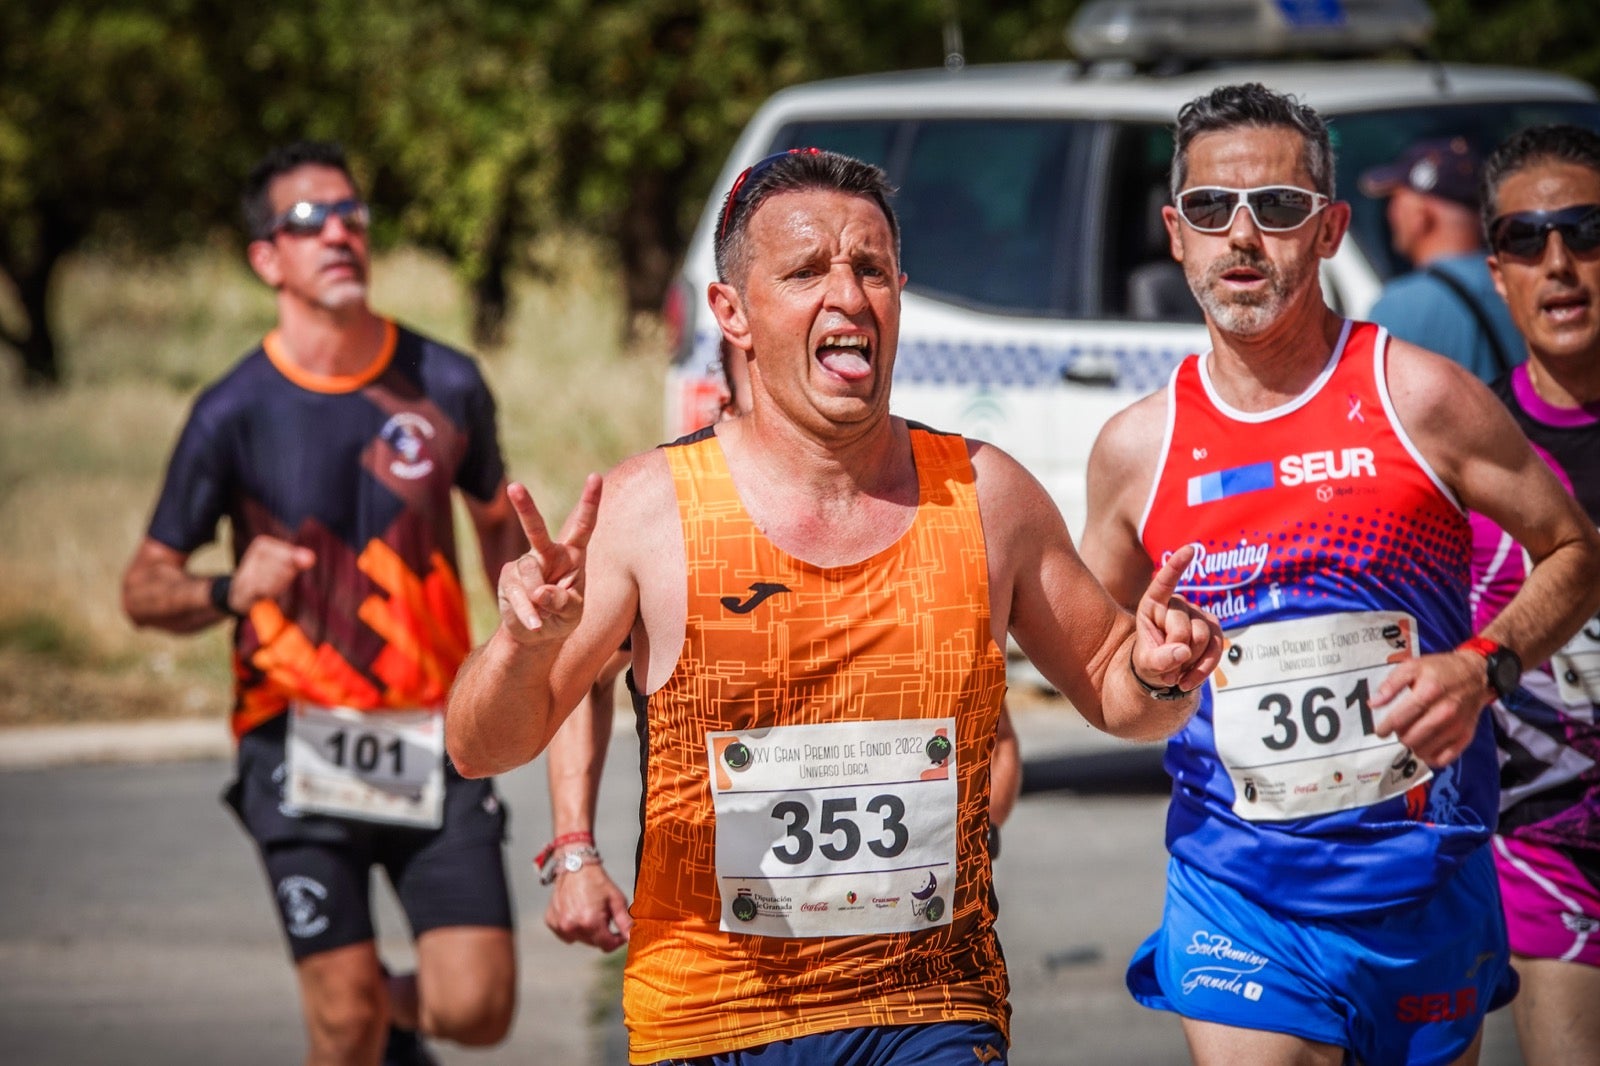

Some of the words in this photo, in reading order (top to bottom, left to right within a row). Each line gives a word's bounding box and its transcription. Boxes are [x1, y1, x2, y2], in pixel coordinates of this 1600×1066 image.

[1279, 447, 1376, 486] SEUR
[1258, 677, 1376, 751] 361
[327, 729, 404, 775] 101
[804, 743, 840, 761] PREMIO
[860, 739, 892, 758] FONDO
[895, 736, 923, 755] 2022
[799, 763, 839, 779] UNIVERSO
[842, 760, 869, 776] LORCA
[771, 795, 909, 865] 353
[754, 893, 792, 904] Diputación
[1396, 987, 1477, 1023] SEUR
